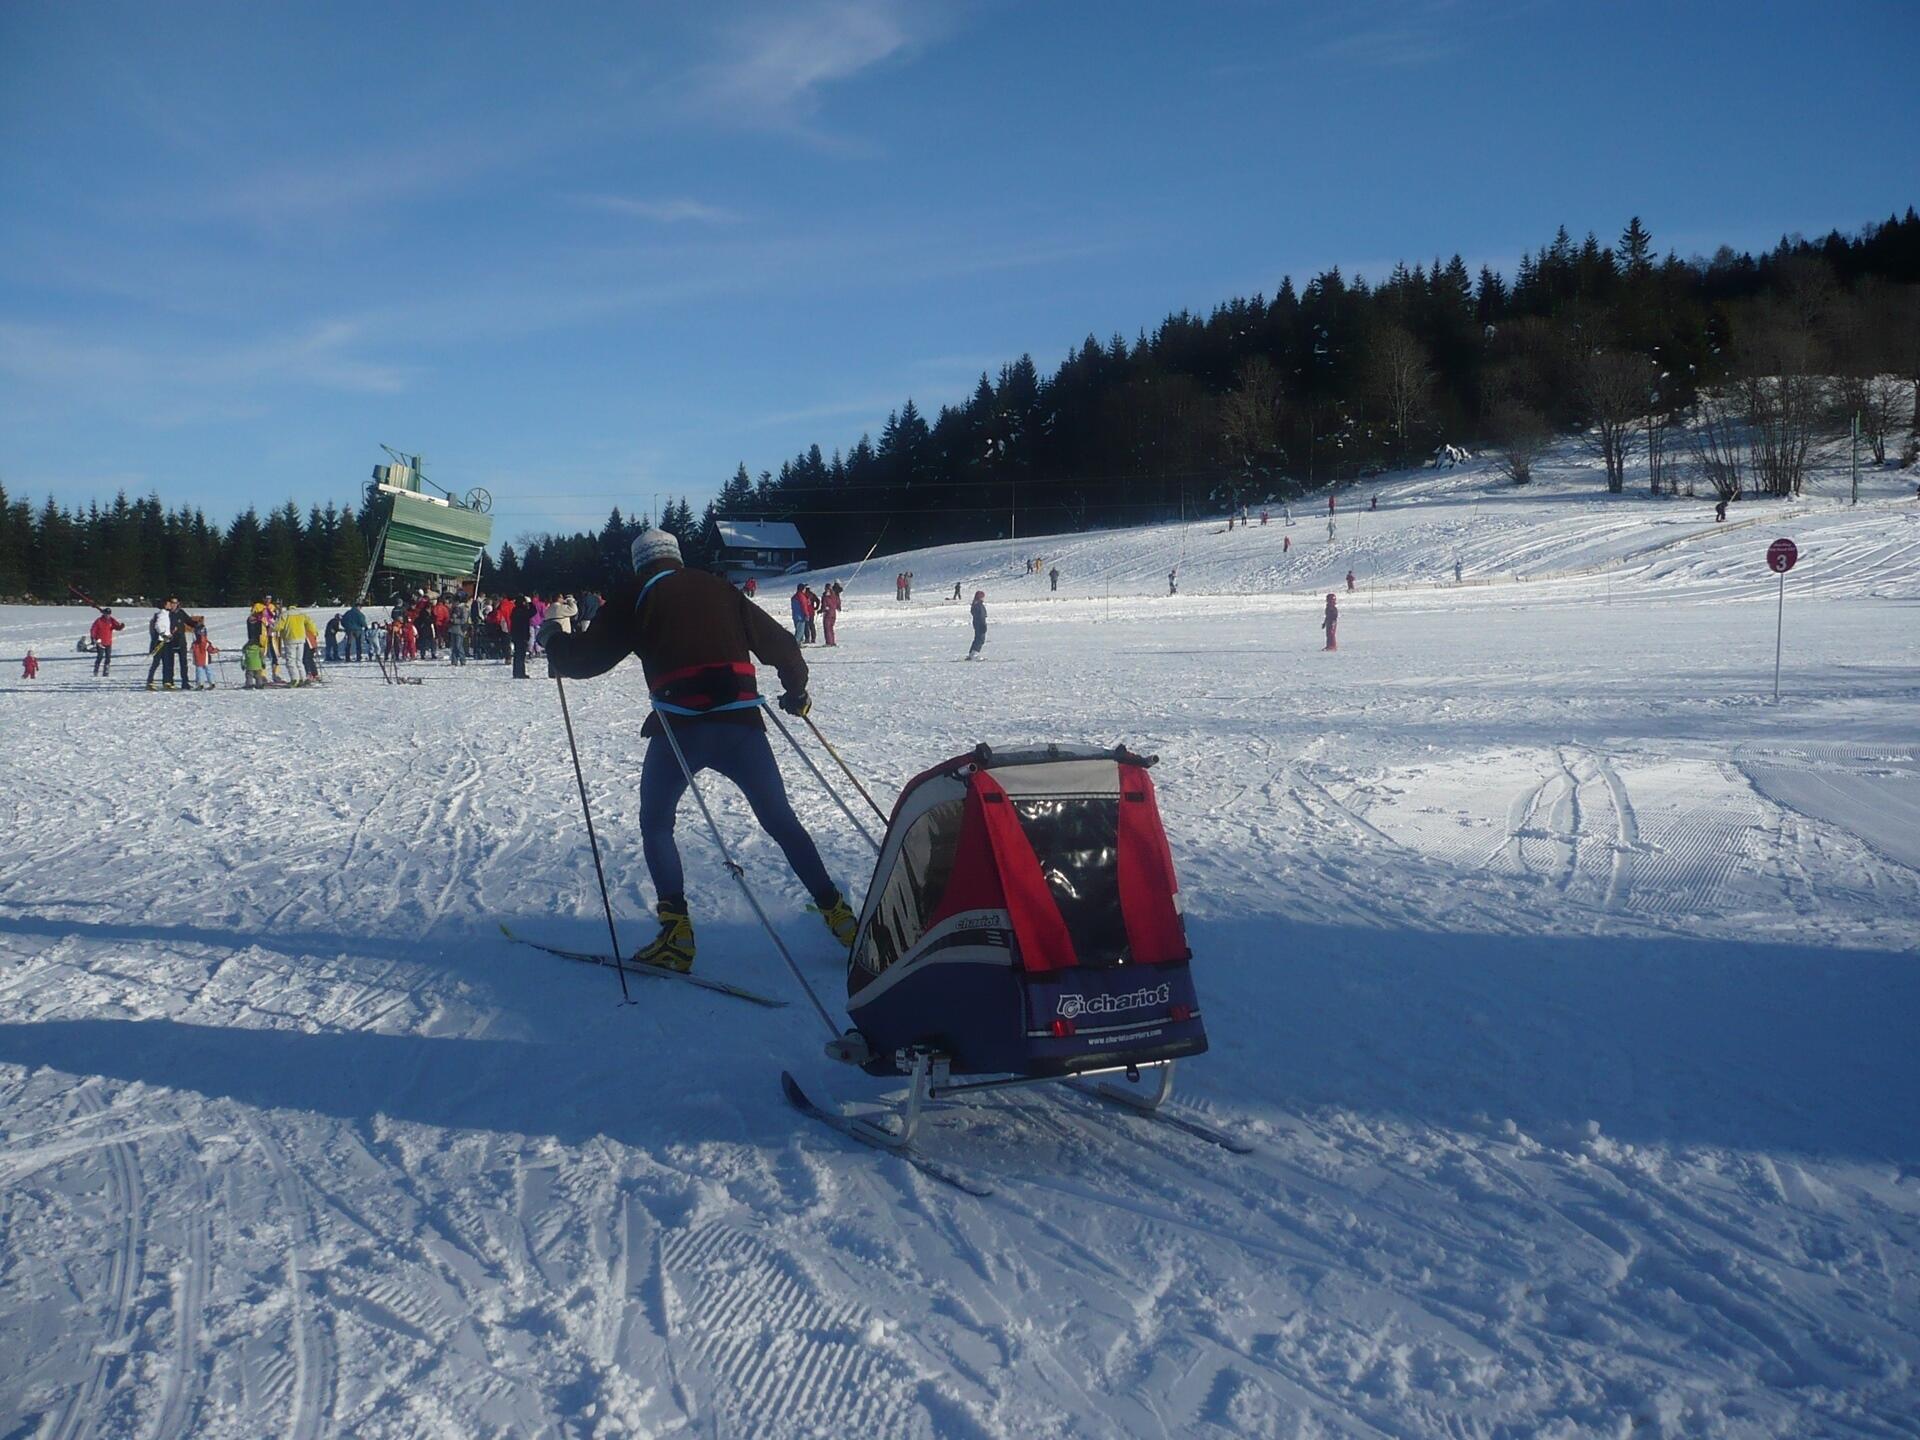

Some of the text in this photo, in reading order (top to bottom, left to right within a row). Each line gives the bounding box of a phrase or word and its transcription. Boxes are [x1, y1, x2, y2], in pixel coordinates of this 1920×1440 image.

[1776, 554, 1787, 571] 3
[955, 914, 1000, 929] chariot
[1087, 983, 1169, 1013] chariot
